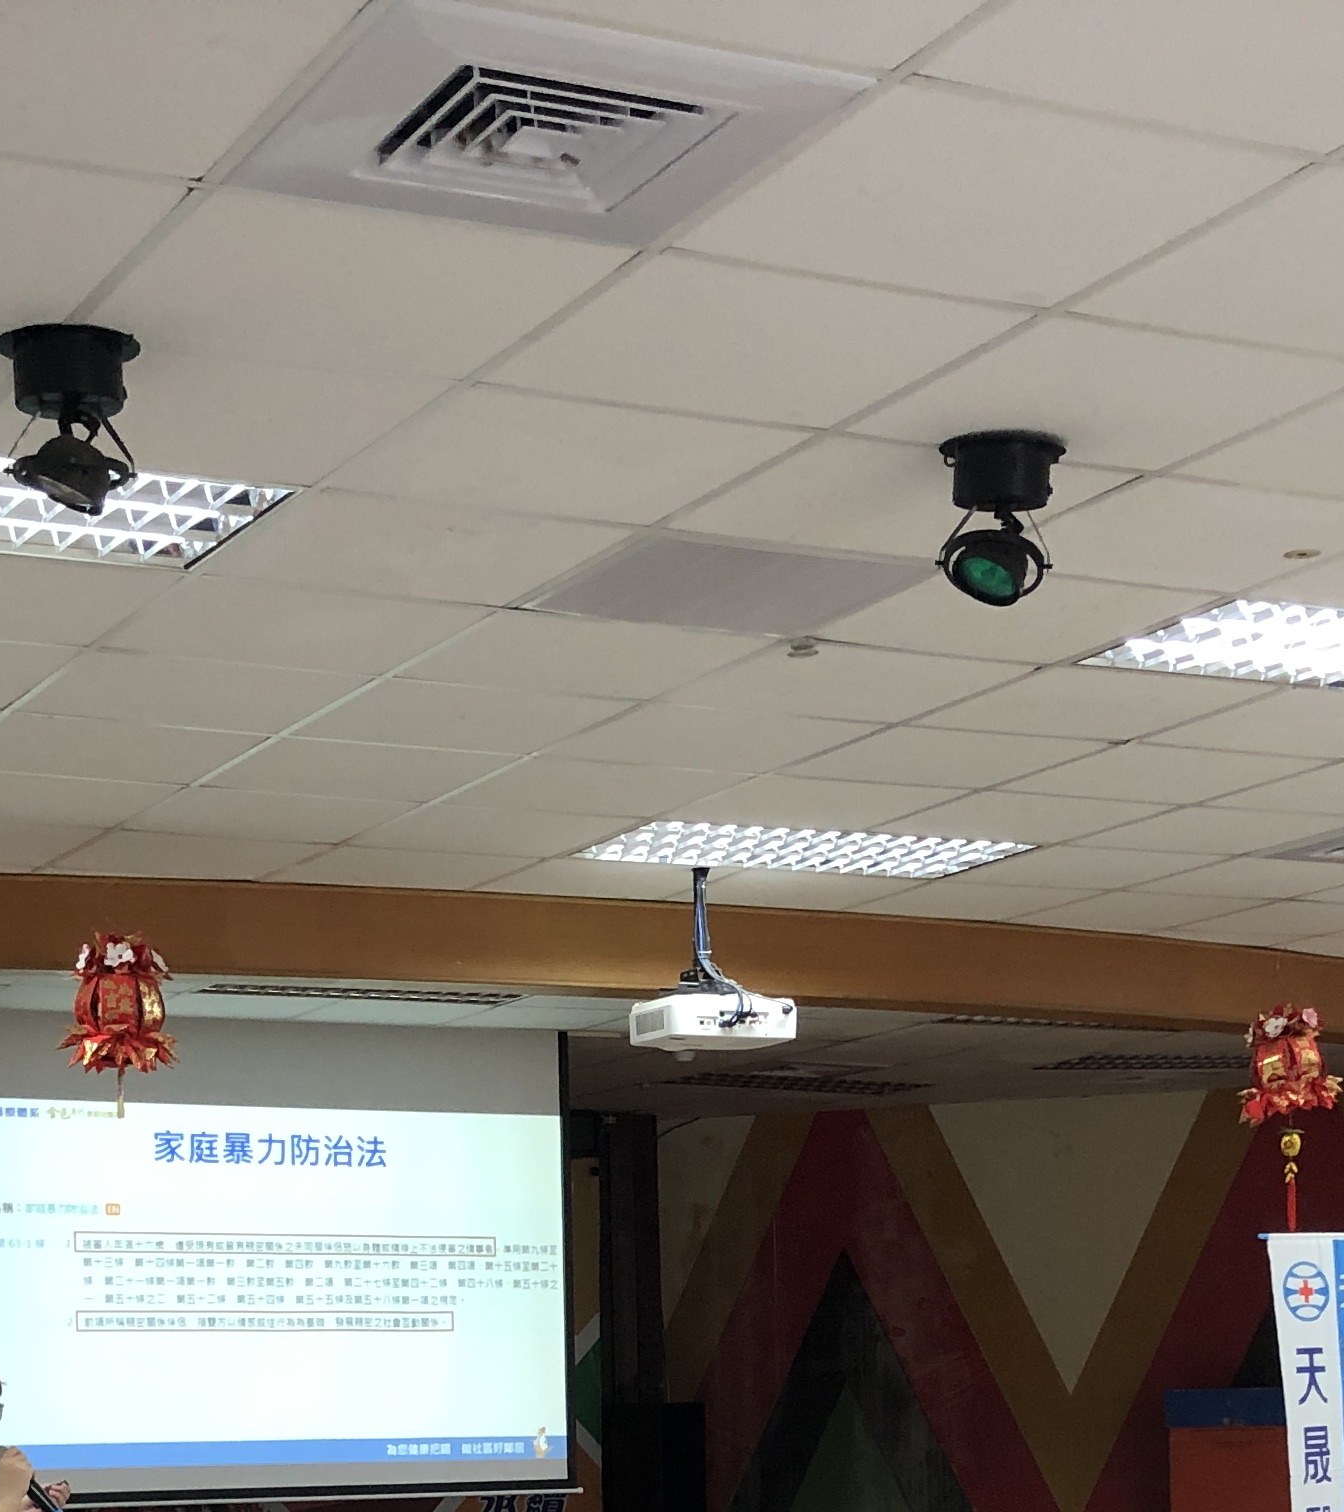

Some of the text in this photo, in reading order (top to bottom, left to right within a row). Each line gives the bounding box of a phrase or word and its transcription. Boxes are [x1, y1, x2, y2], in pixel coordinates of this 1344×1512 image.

[153, 1131, 388, 1169] 家庭暴力防治法
